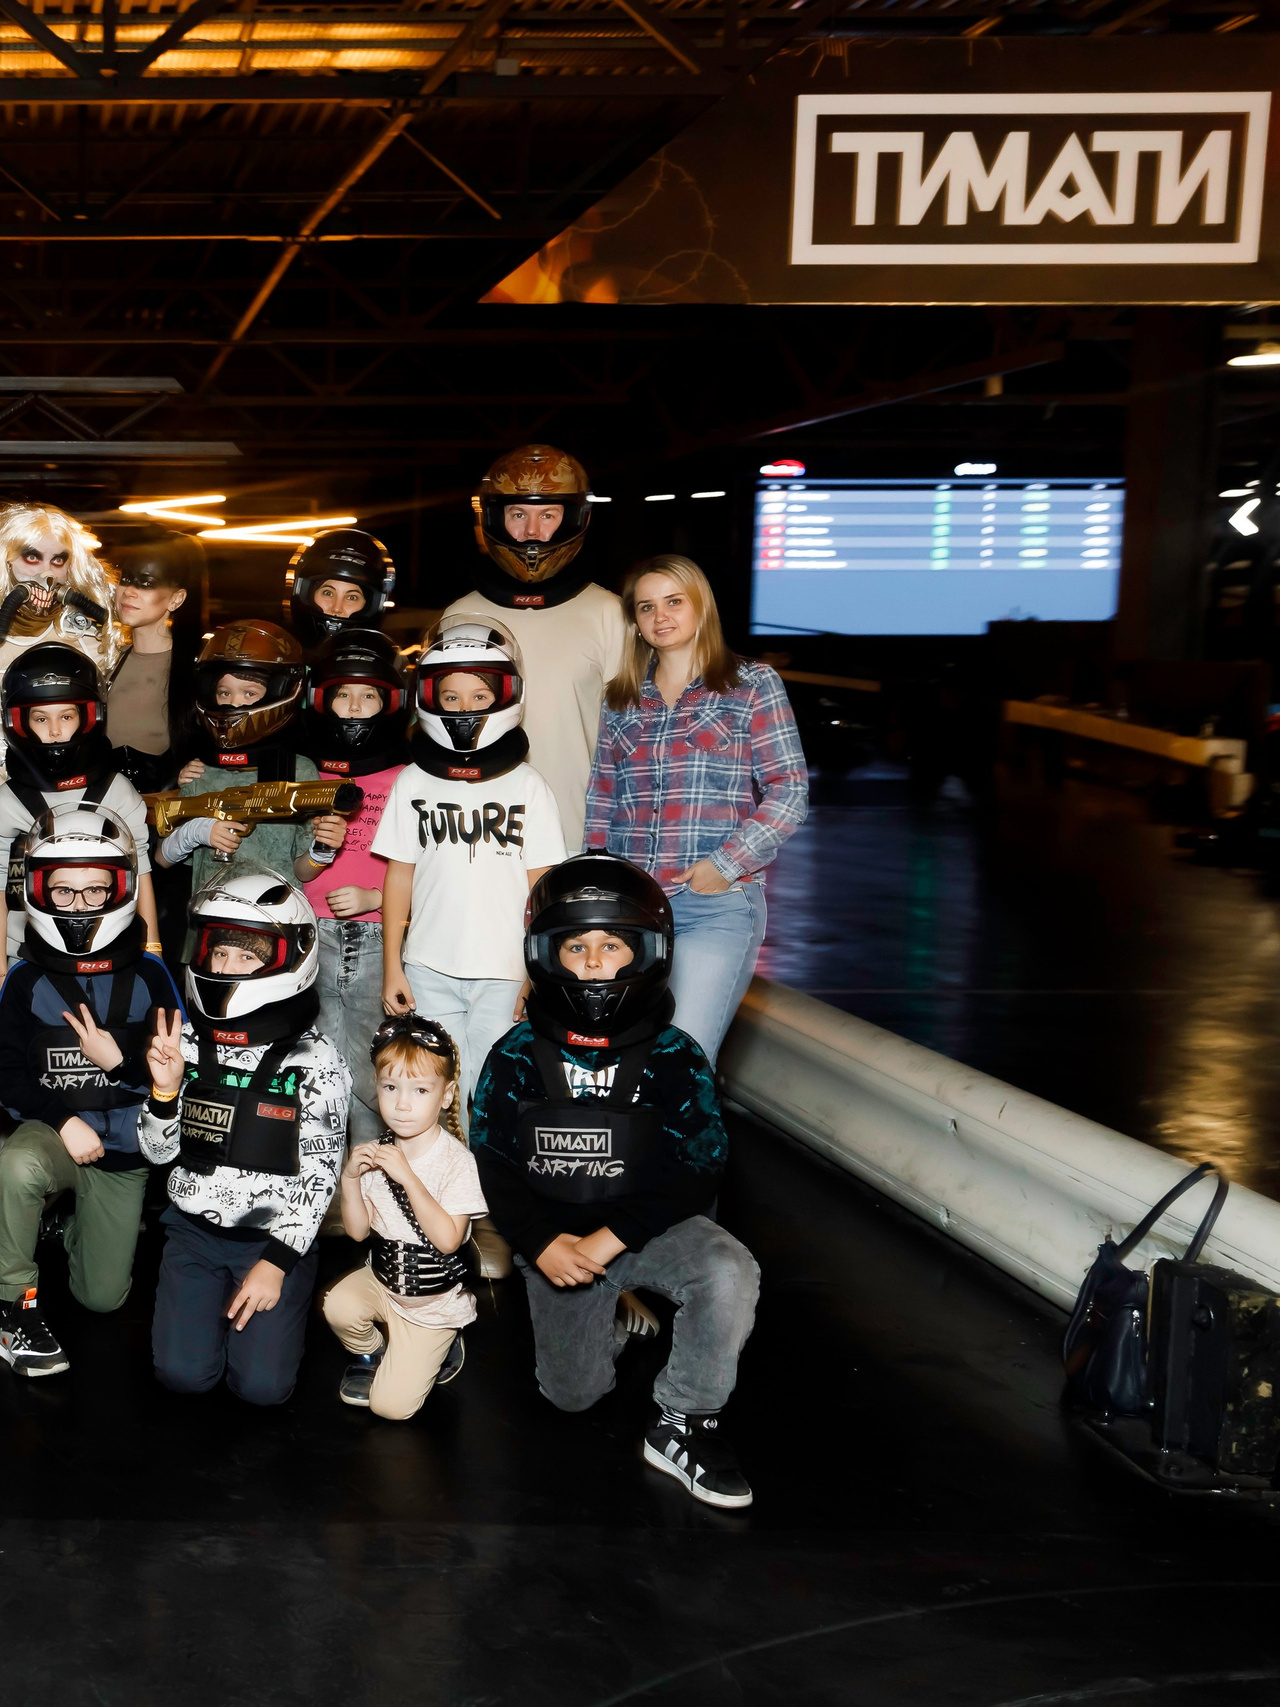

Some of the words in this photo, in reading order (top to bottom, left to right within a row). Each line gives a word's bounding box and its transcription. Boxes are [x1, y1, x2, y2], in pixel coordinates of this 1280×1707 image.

[829, 130, 1232, 226] ТИМАТИ
[450, 768, 479, 776] RLG
[59, 776, 85, 787] RLG
[361, 804, 385, 814] APPY
[411, 799, 526, 858] FUTURE
[216, 1032, 245, 1041] RLG
[261, 1106, 292, 1118] RLG
[540, 1133, 606, 1151] ТИМАТИ
[527, 1155, 625, 1178] KARTING
